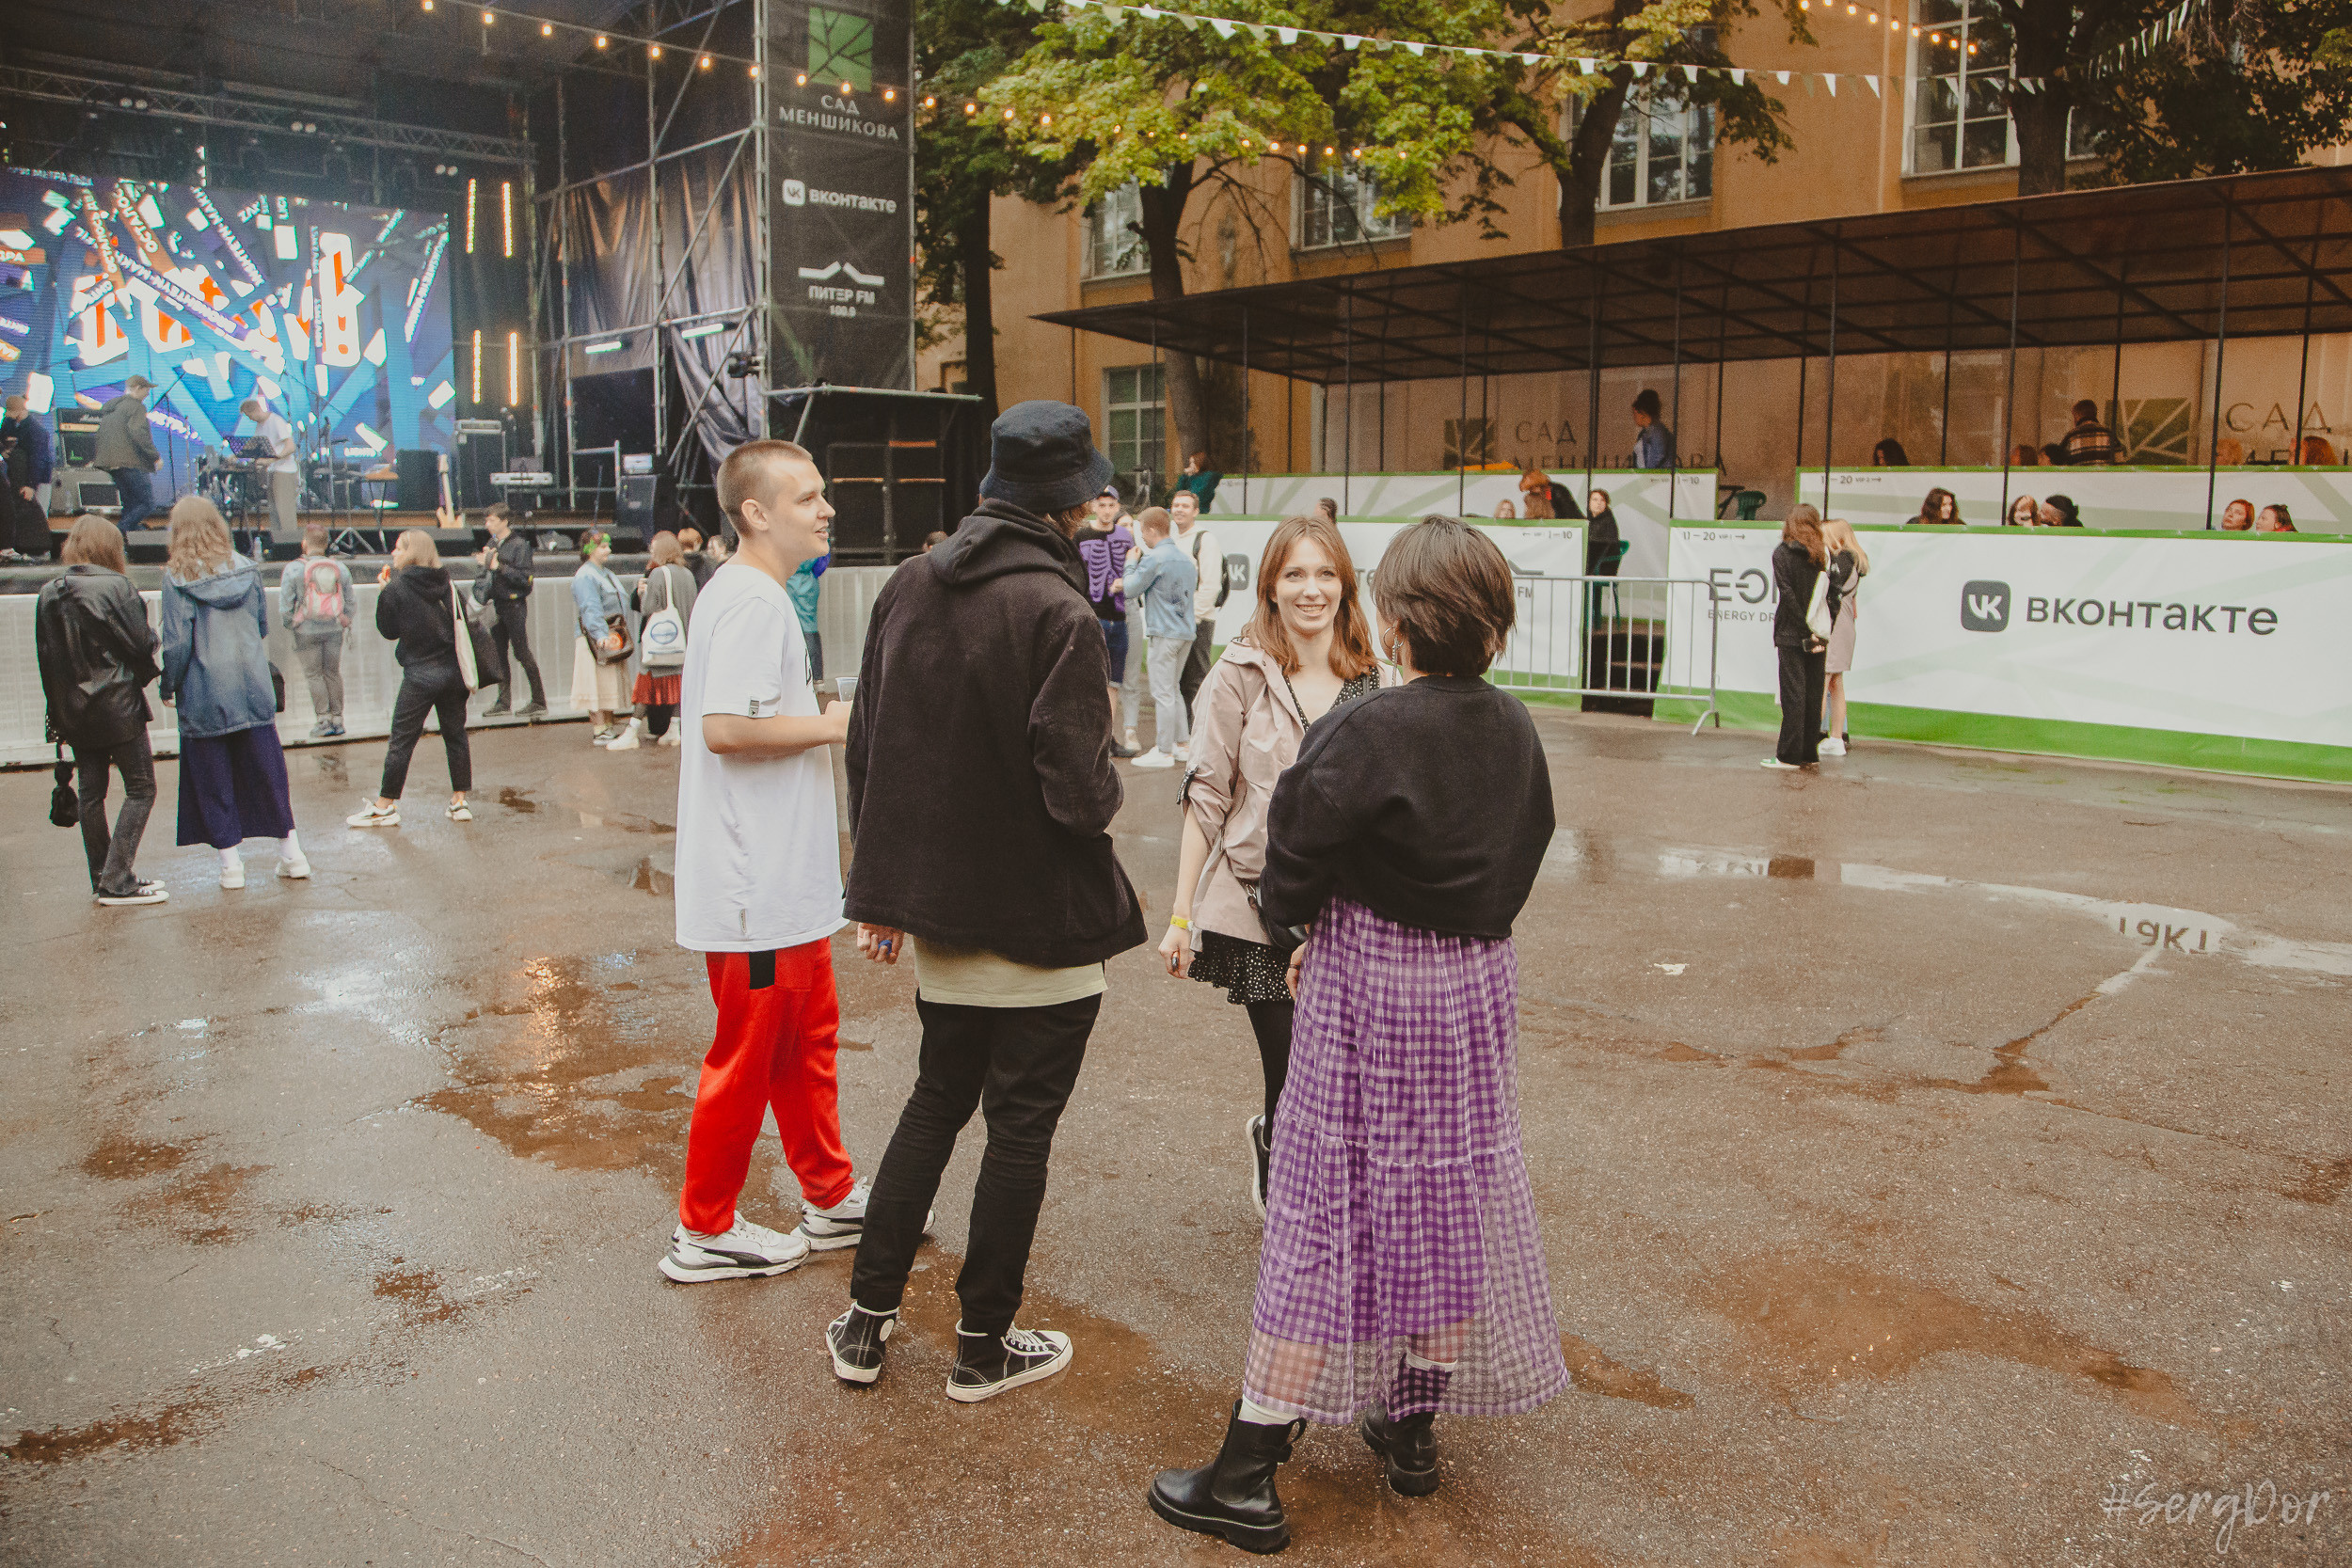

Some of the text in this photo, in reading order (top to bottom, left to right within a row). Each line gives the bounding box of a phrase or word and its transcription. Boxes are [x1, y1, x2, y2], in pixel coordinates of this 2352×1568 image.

[821, 95, 860, 116] САД
[779, 106, 898, 140] МЕНШИКОВА
[809, 189, 898, 214] вконтакте
[809, 285, 875, 305] ПИТЕР FM
[2226, 401, 2331, 433] САД
[1516, 420, 1577, 444] САД
[1840, 475, 1853, 484] 20
[1563, 530, 1573, 539] 10
[1703, 531, 1716, 541] 20
[1708, 609, 1755, 622] ENERGY
[2026, 596, 2279, 636] вконтакте
